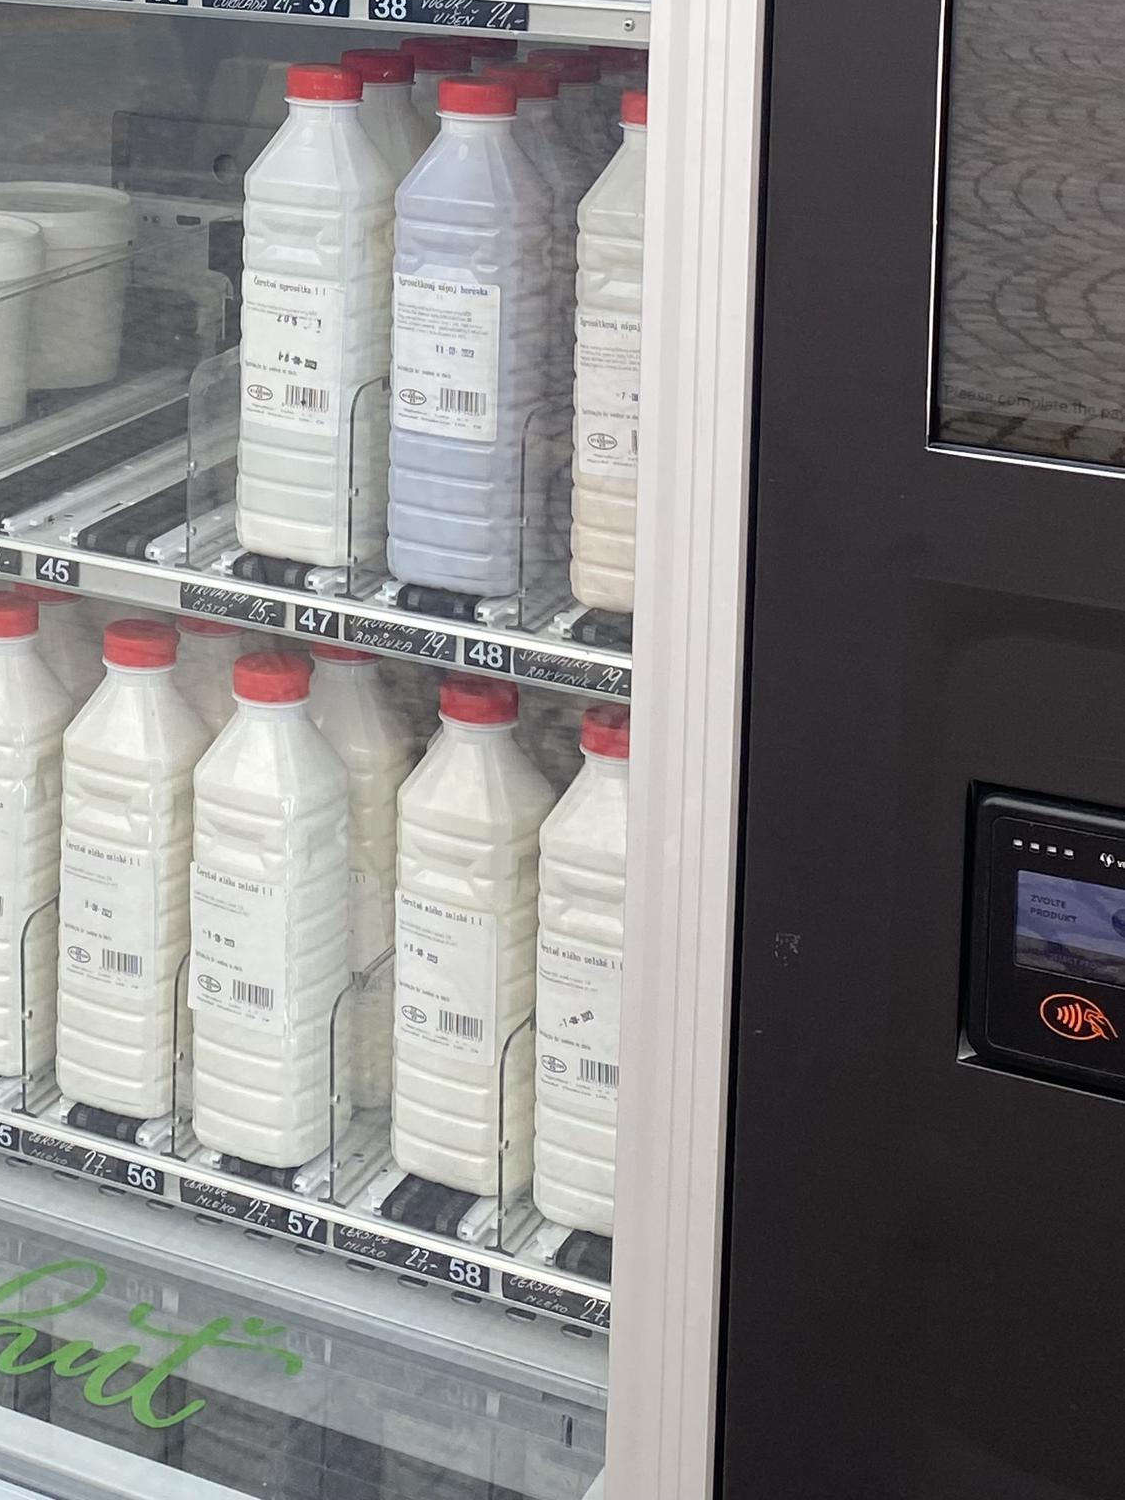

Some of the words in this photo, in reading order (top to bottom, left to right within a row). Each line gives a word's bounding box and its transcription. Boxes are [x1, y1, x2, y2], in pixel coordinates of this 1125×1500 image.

[433, 7, 480, 26] VIŠEŇ
[39, 557, 70, 583] 45
[191, 597, 234, 615] ČISTÁ
[299, 607, 332, 633] 47
[353, 630, 414, 652] BORŮVKA
[469, 640, 504, 668] 48
[525, 666, 591, 688] RAKYTNÍK
[1030, 894, 1067, 909] ZVOLTE
[1030, 907, 1078, 923] PRODUKT
[126, 1164, 156, 1191] 56
[195, 1193, 237, 1215] MLÉKO
[287, 1211, 320, 1238] 57
[448, 1259, 482, 1287] 58
